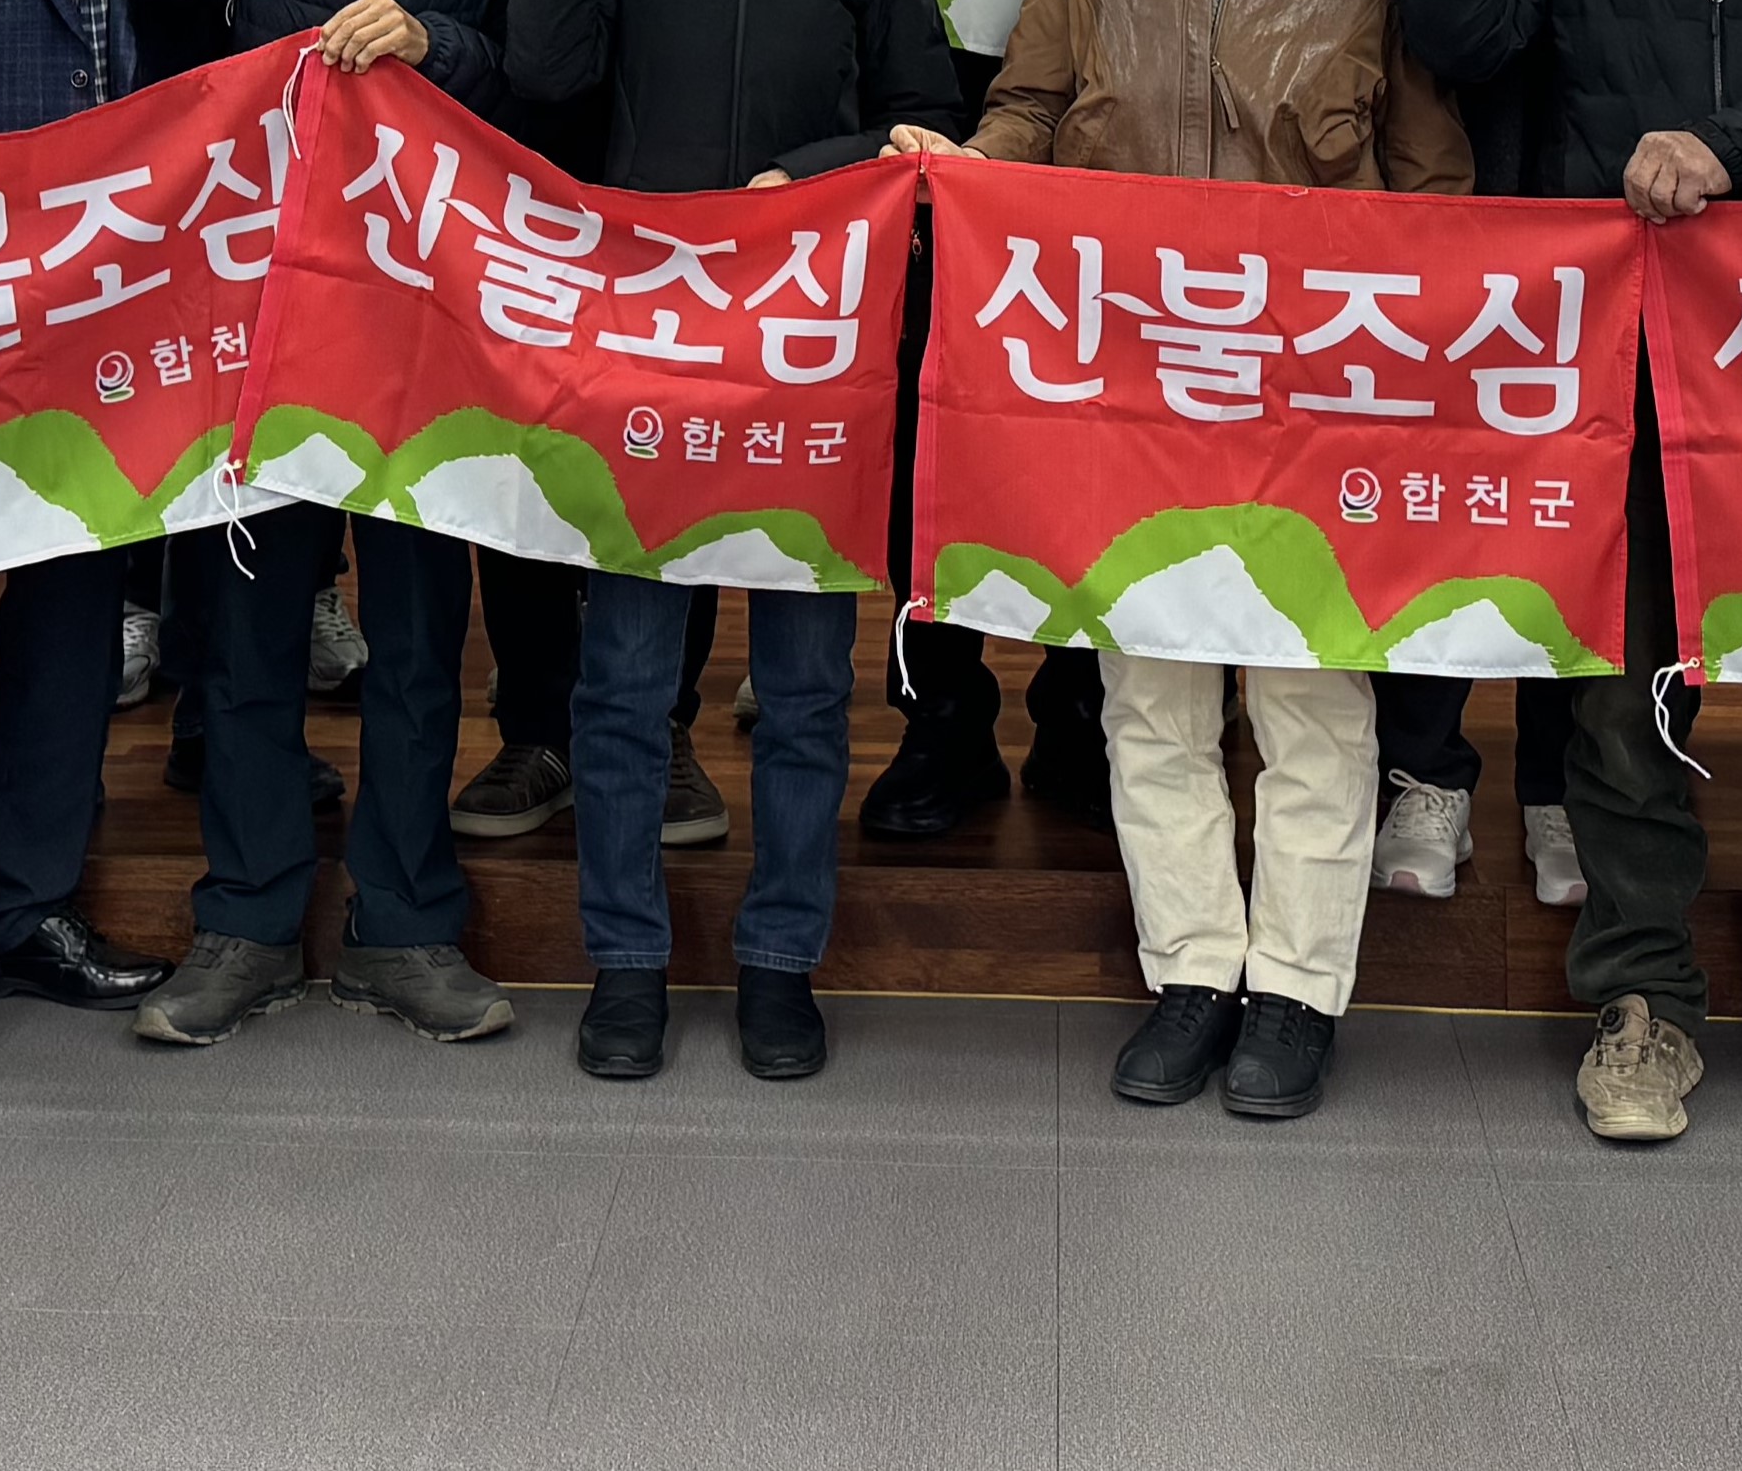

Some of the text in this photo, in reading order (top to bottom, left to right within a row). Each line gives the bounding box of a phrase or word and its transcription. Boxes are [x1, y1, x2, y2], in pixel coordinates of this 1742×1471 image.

[342, 123, 869, 385] 산불조심
[149, 322, 250, 387] 합천
[974, 235, 1585, 436] 산불조심
[680, 416, 848, 466] 합천군
[1400, 471, 1576, 530] 합천군
